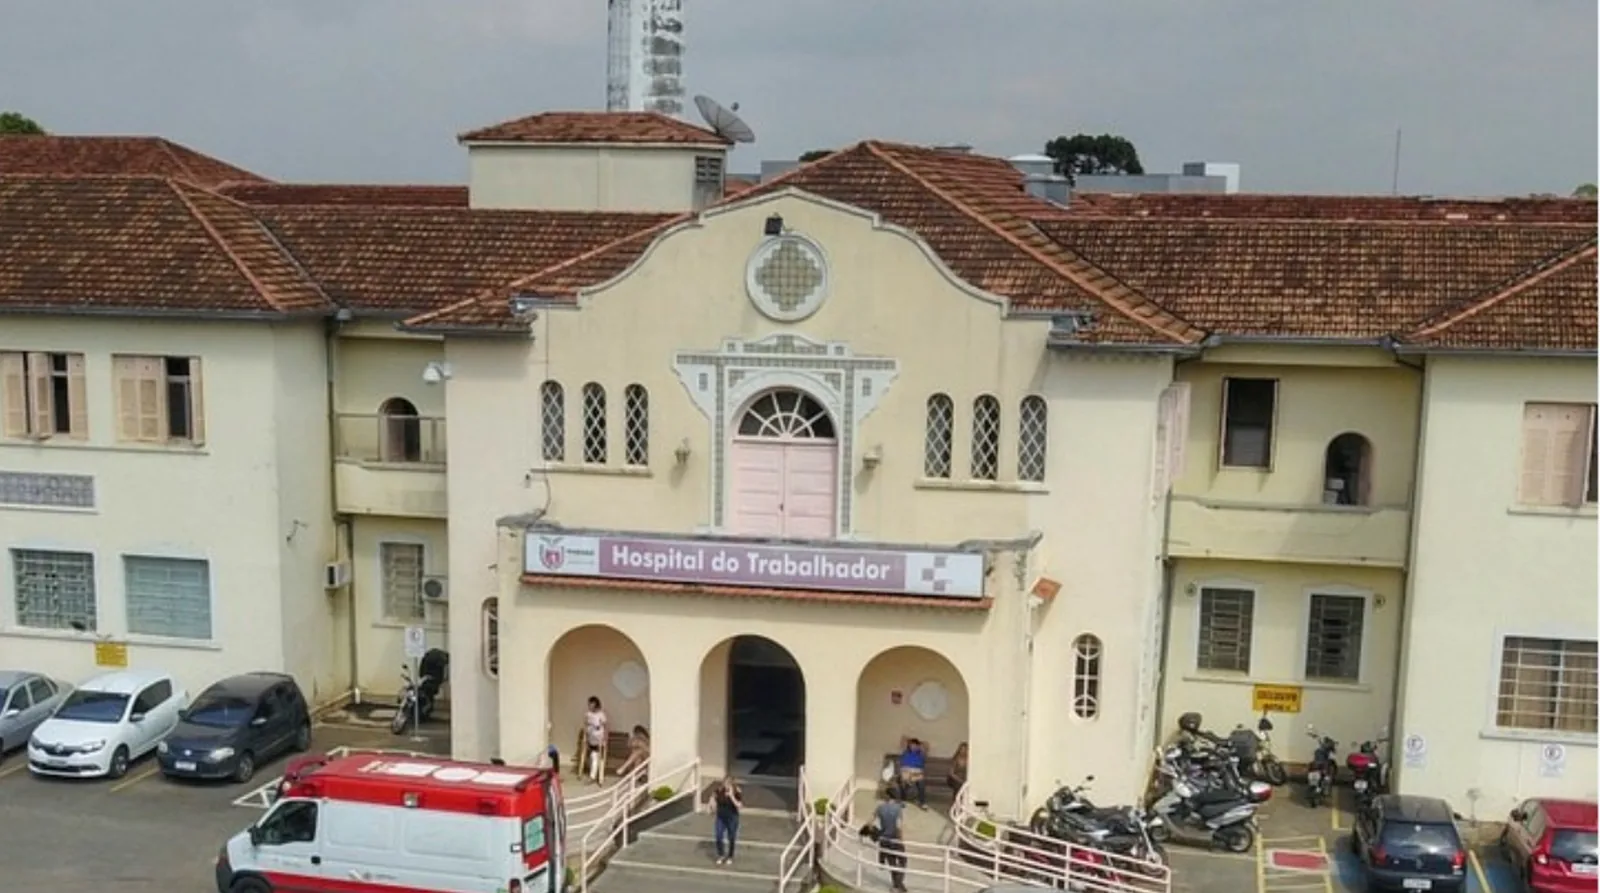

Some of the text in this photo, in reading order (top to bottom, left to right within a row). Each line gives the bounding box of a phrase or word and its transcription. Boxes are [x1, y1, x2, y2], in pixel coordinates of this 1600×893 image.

[612, 545, 890, 580] Hospital do Trabalhador
